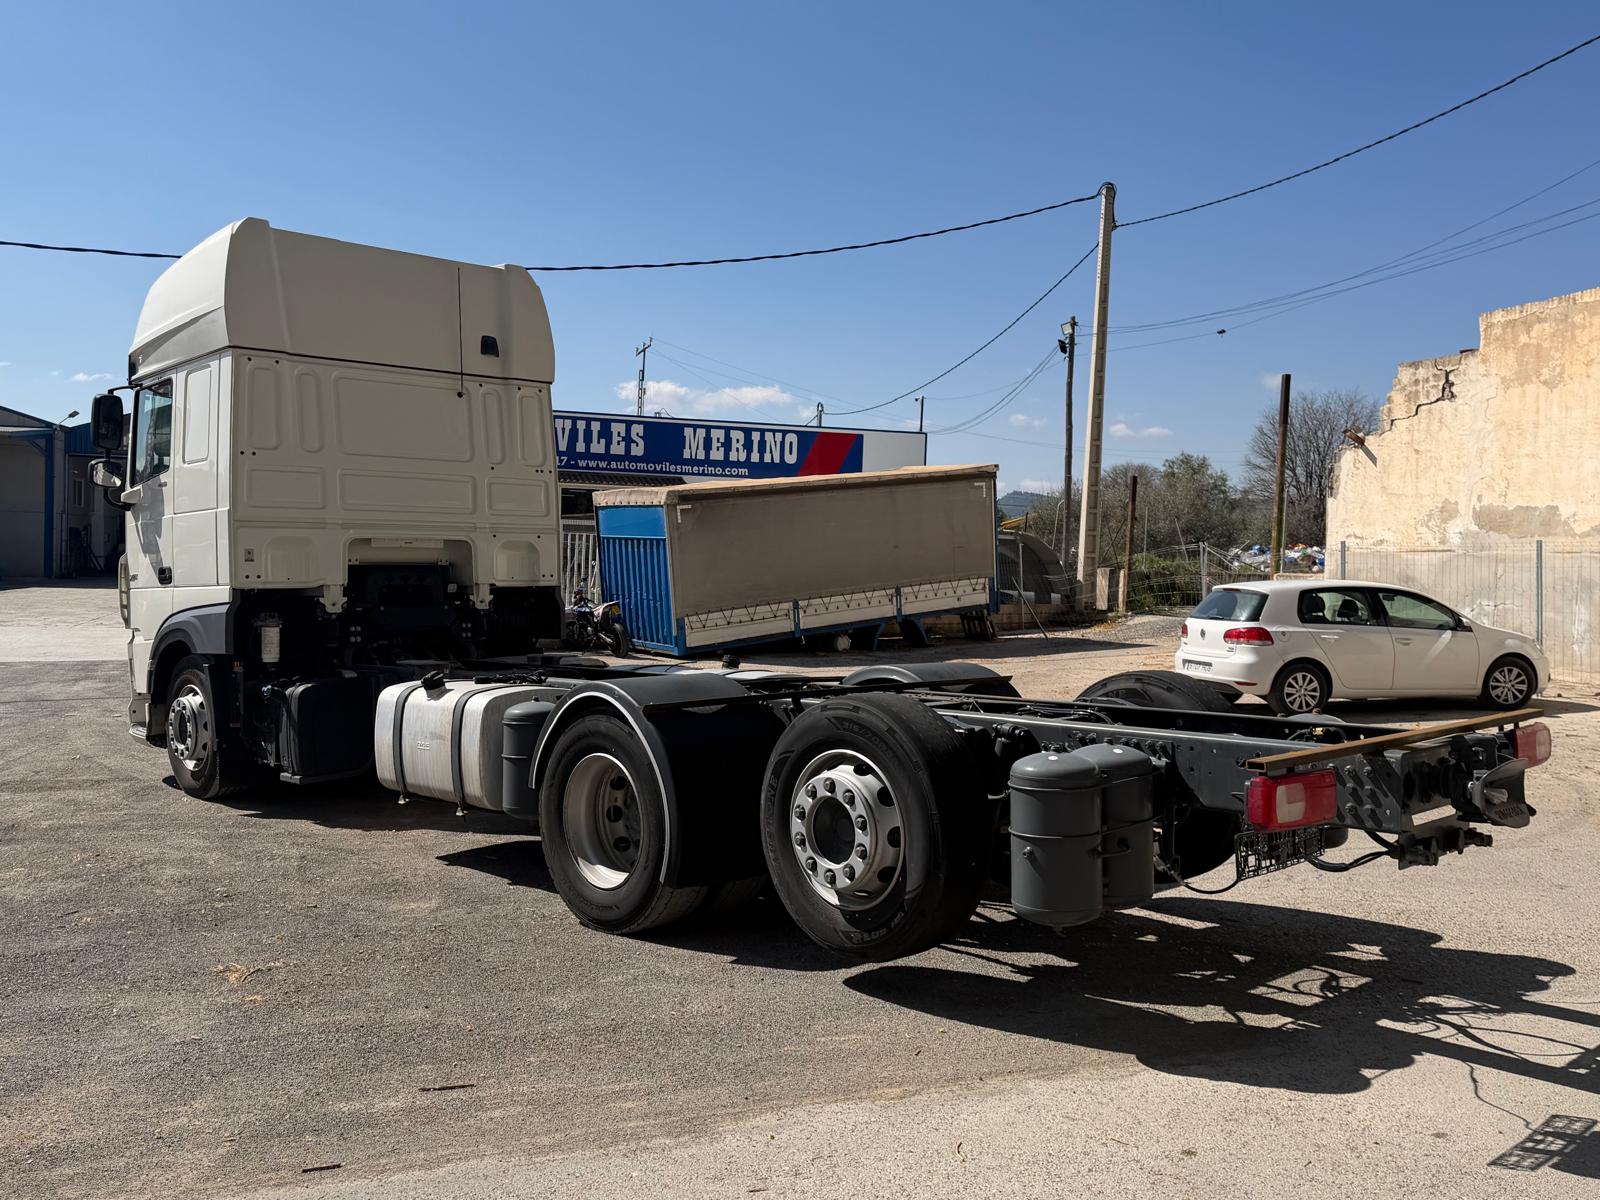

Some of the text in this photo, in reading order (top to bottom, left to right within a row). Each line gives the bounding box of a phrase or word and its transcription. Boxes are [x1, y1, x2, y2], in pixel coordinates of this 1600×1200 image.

[555, 418, 798, 465] VILES MERINO
[578, 459, 749, 476] www.automovilesmerino.com
